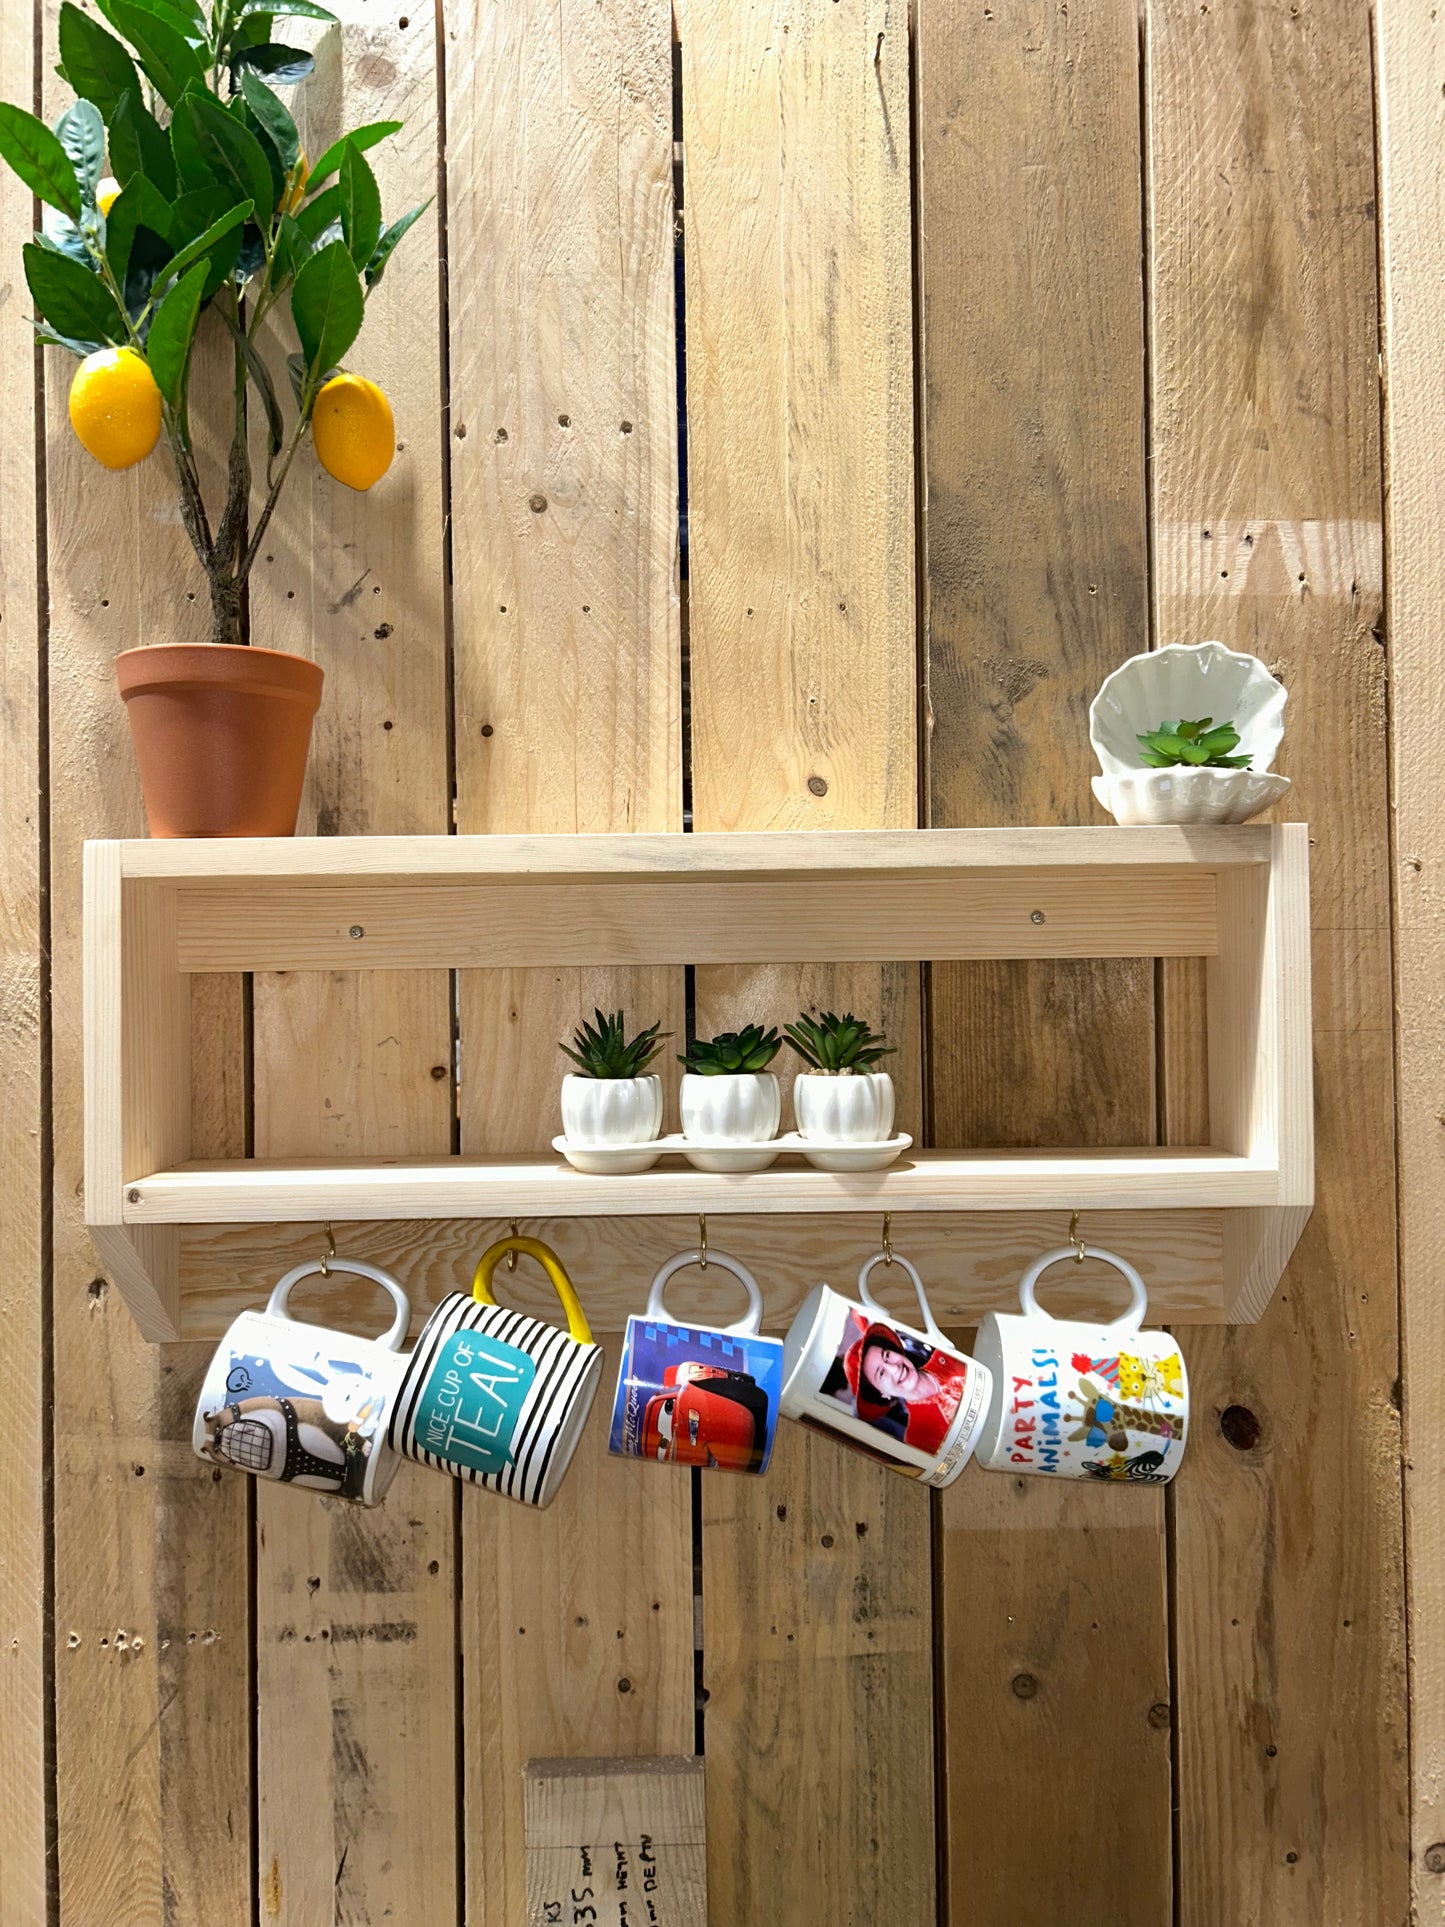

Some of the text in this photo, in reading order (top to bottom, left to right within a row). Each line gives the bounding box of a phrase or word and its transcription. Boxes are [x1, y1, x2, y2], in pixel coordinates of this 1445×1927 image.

[426, 1340, 475, 1447] NICE CUP OF
[445, 1351, 525, 1456] TEA!
[1010, 1375, 1037, 1464] PARTY
[571, 1887, 598, 1927] 35
